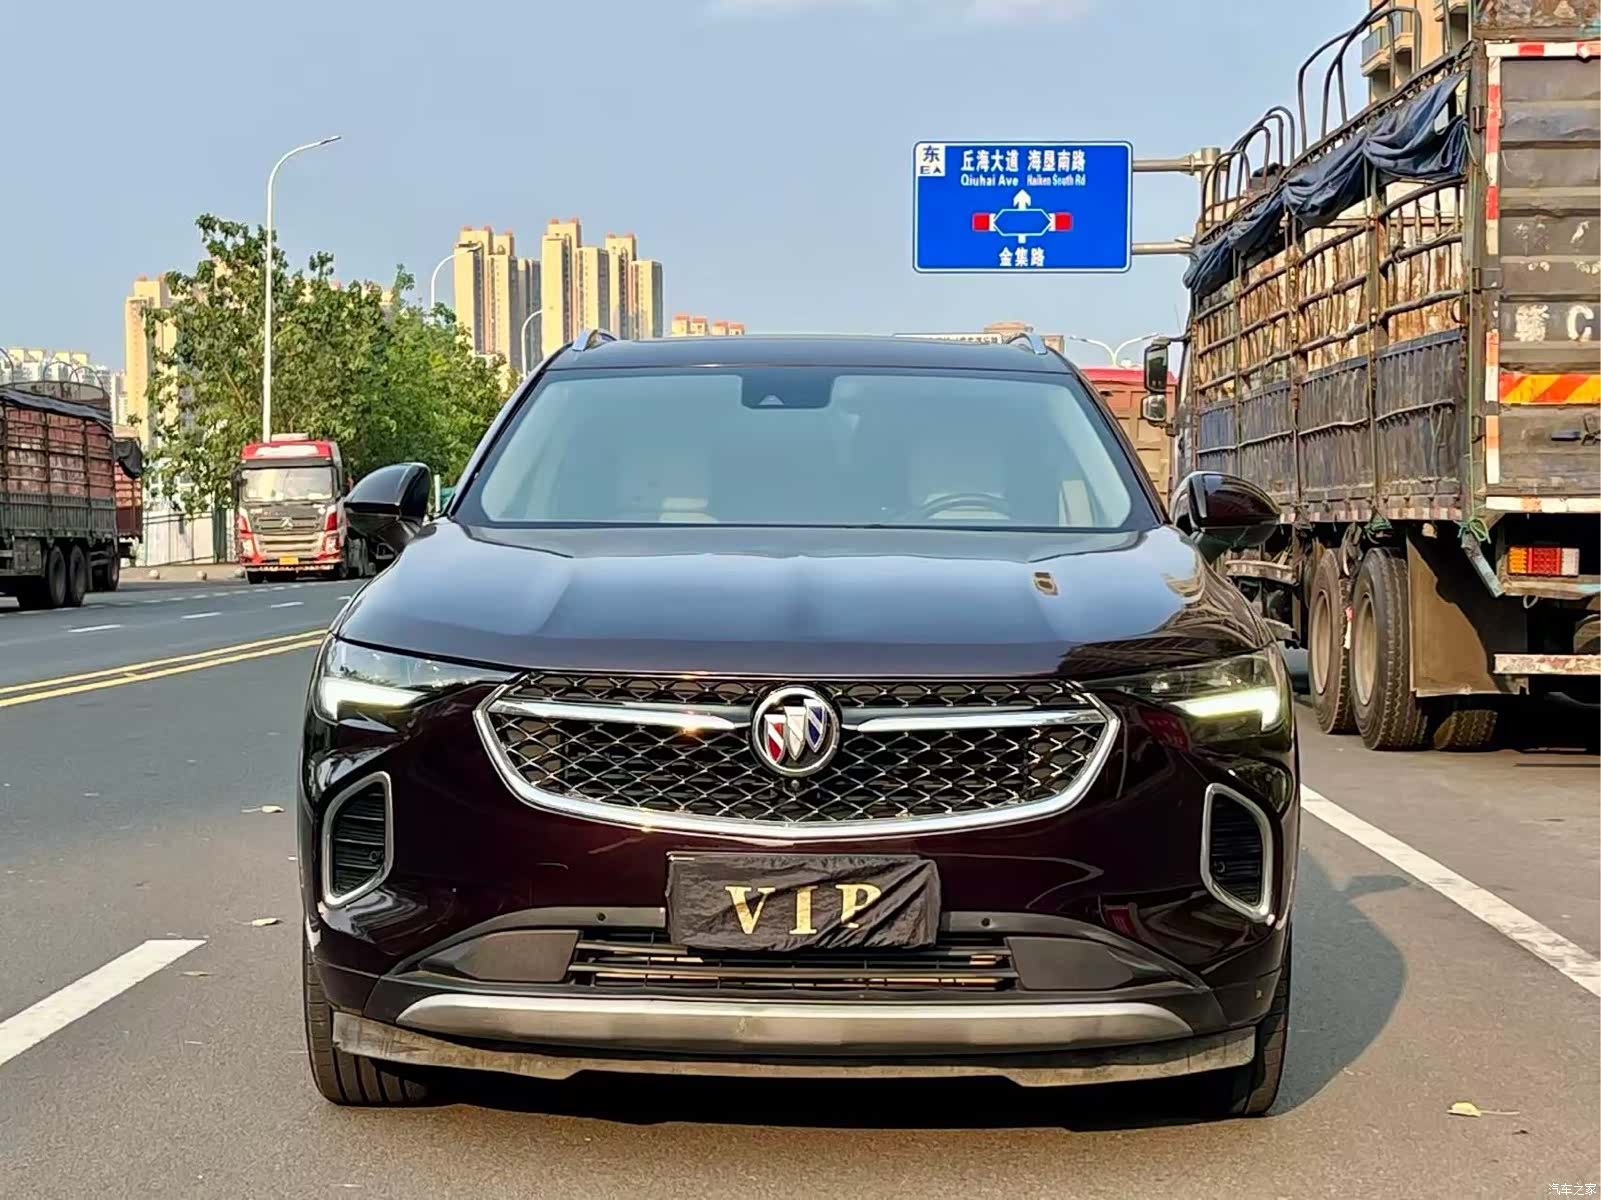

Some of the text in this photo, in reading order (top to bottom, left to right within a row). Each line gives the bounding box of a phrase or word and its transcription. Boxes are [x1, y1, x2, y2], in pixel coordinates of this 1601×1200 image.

[923, 145, 940, 163] 东
[960, 149, 1086, 173] 丘海大道 海垦南路
[960, 173, 996, 187] Qiuhai
[998, 174, 1019, 187] Ave
[1053, 173, 1074, 187] South
[1075, 173, 1087, 187] Rd
[999, 247, 1045, 267] 金集路
[725, 884, 882, 935] VIP
